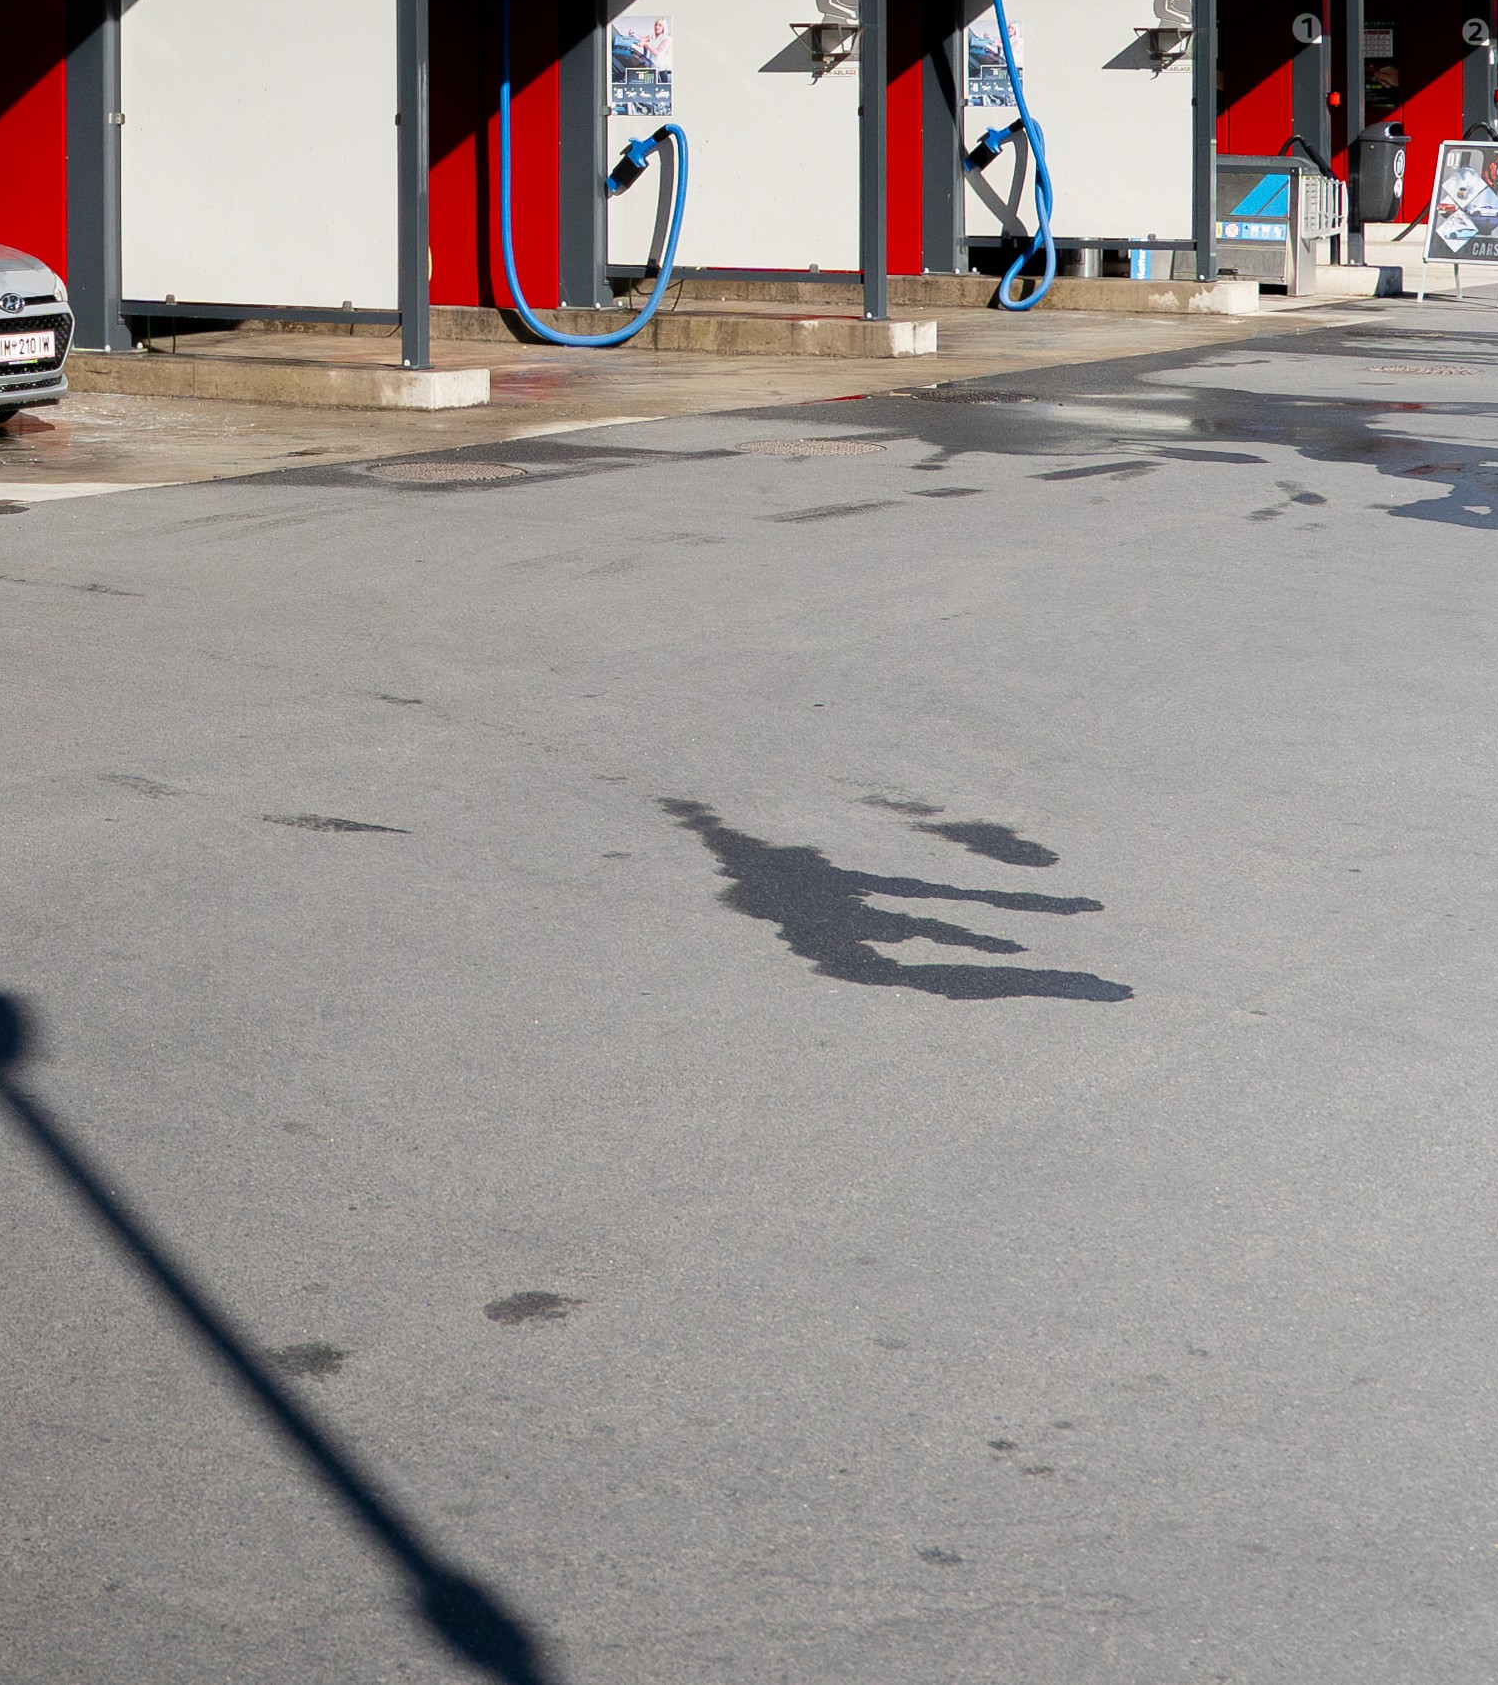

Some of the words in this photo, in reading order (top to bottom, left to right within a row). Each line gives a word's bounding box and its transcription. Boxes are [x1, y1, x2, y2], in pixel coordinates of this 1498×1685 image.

[1302, 19, 1313, 38] 1
[1468, 22, 1484, 42] 2
[0, 340, 11, 356] IM
[19, 338, 36, 354] 210
